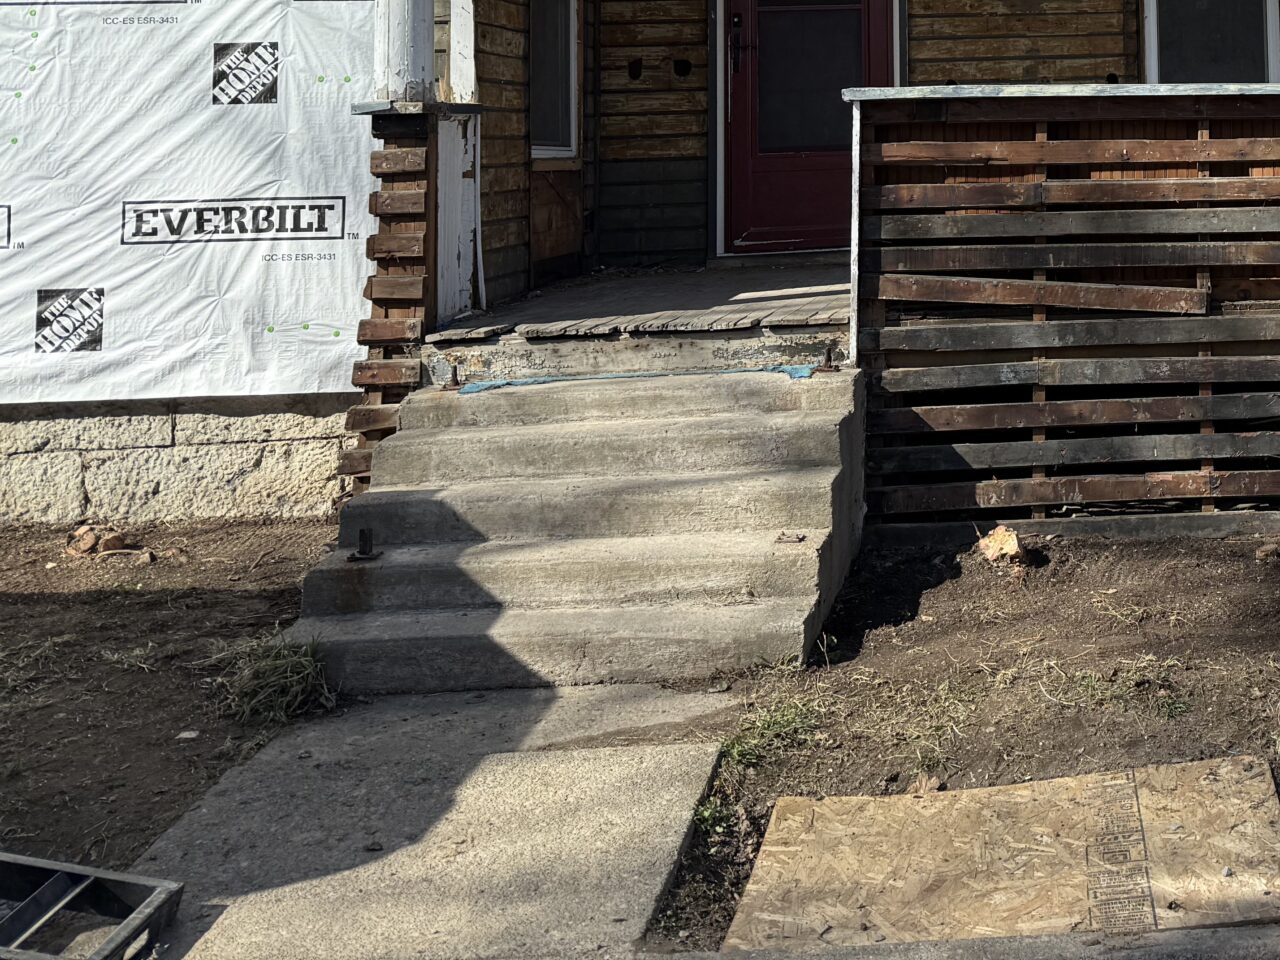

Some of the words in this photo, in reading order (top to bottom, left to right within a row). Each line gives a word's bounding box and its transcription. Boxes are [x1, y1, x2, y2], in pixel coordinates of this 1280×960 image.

[102, 17, 135, 25] ICC-ES
[137, 17, 178, 25] ESR-3431
[212, 41, 278, 104] HOME
[219, 48, 247, 74] THE
[237, 63, 278, 104] DEPOT
[132, 204, 335, 237] EVERBILT
[261, 253, 293, 262] ICC-ES
[295, 253, 336, 261] ESR-3431
[34, 287, 104, 353] HOME
[41, 294, 71, 321] THE
[61, 310, 103, 352] DEPOT
